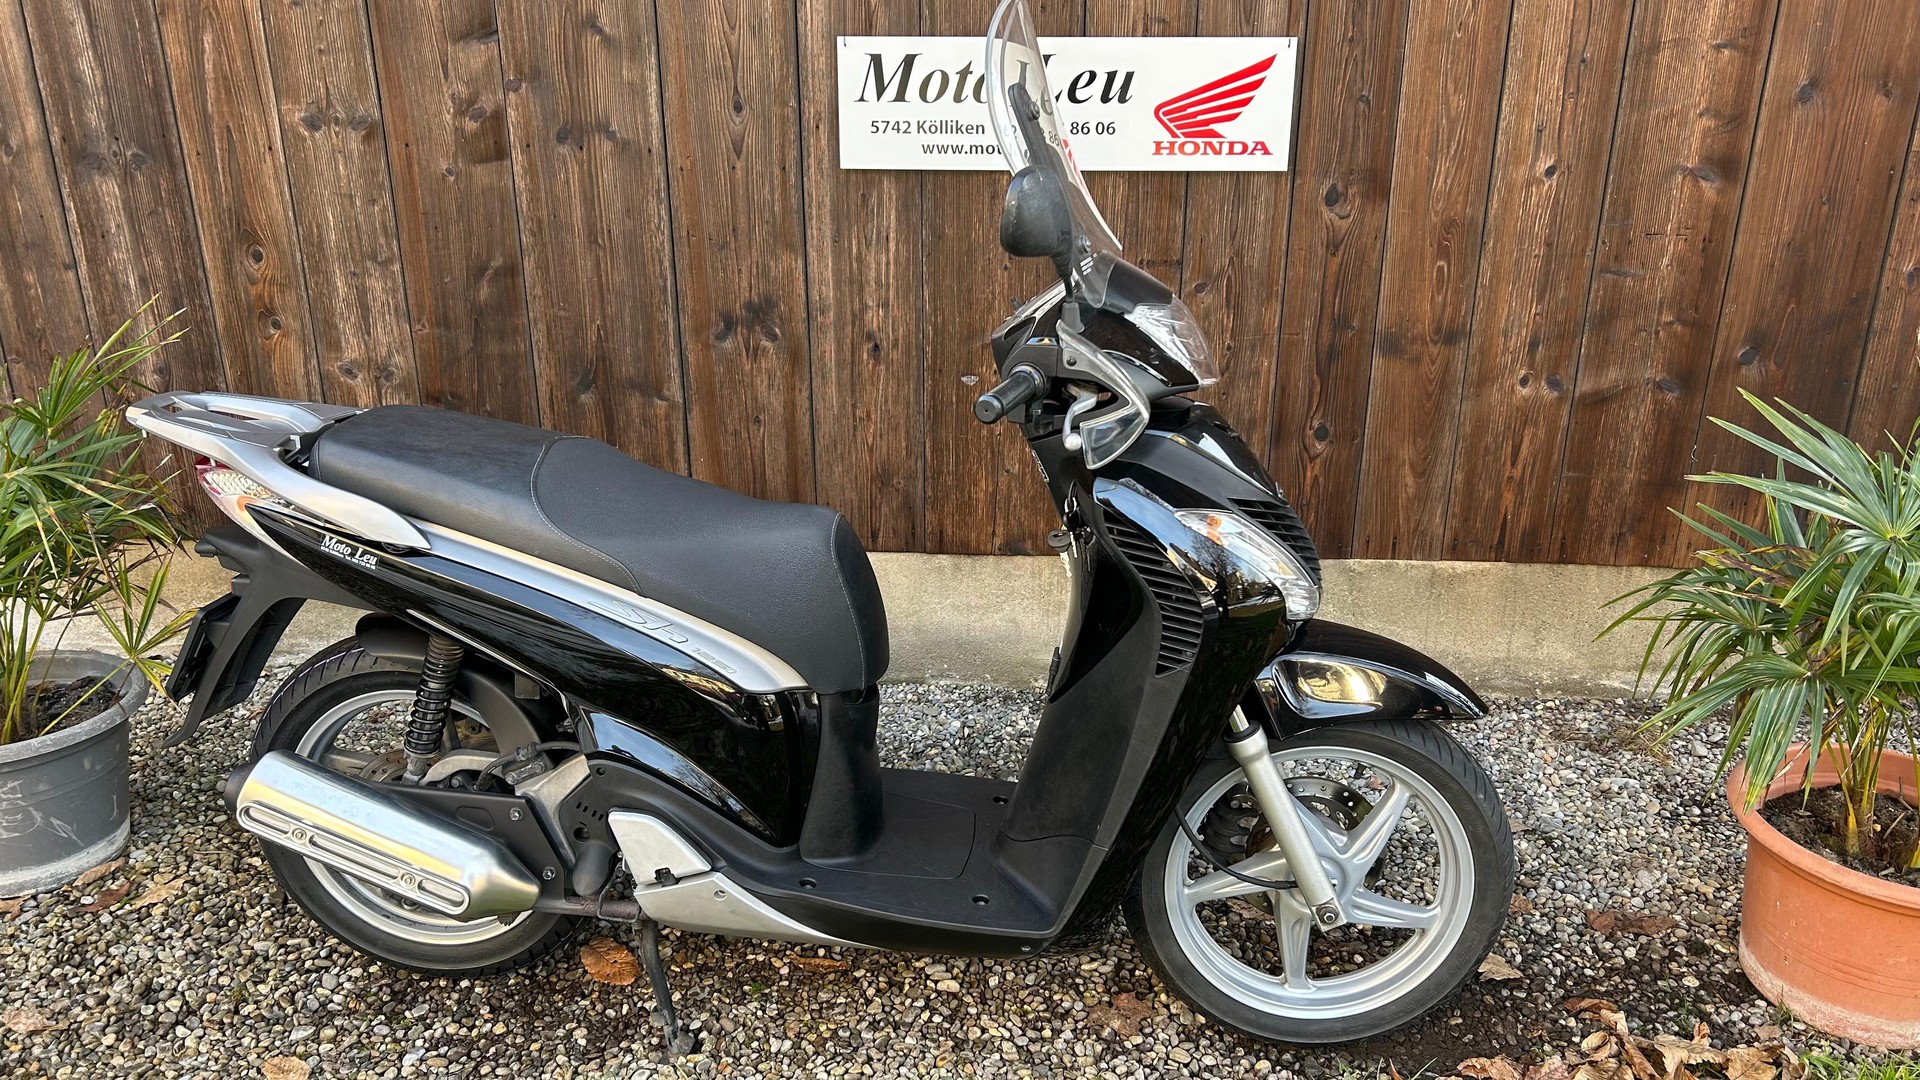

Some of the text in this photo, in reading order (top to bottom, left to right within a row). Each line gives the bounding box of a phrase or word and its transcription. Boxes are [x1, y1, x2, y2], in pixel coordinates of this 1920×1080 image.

[854, 52, 989, 104] Moto
[870, 120, 912, 135] 5742
[916, 119, 986, 135] Kölliken
[1069, 121, 1091, 135] 86
[1095, 121, 1116, 135] 06
[921, 142, 1003, 155] www.mot
[1152, 140, 1273, 156] HONDA
[321, 535, 352, 555] Moto
[354, 547, 378, 565] Leu
